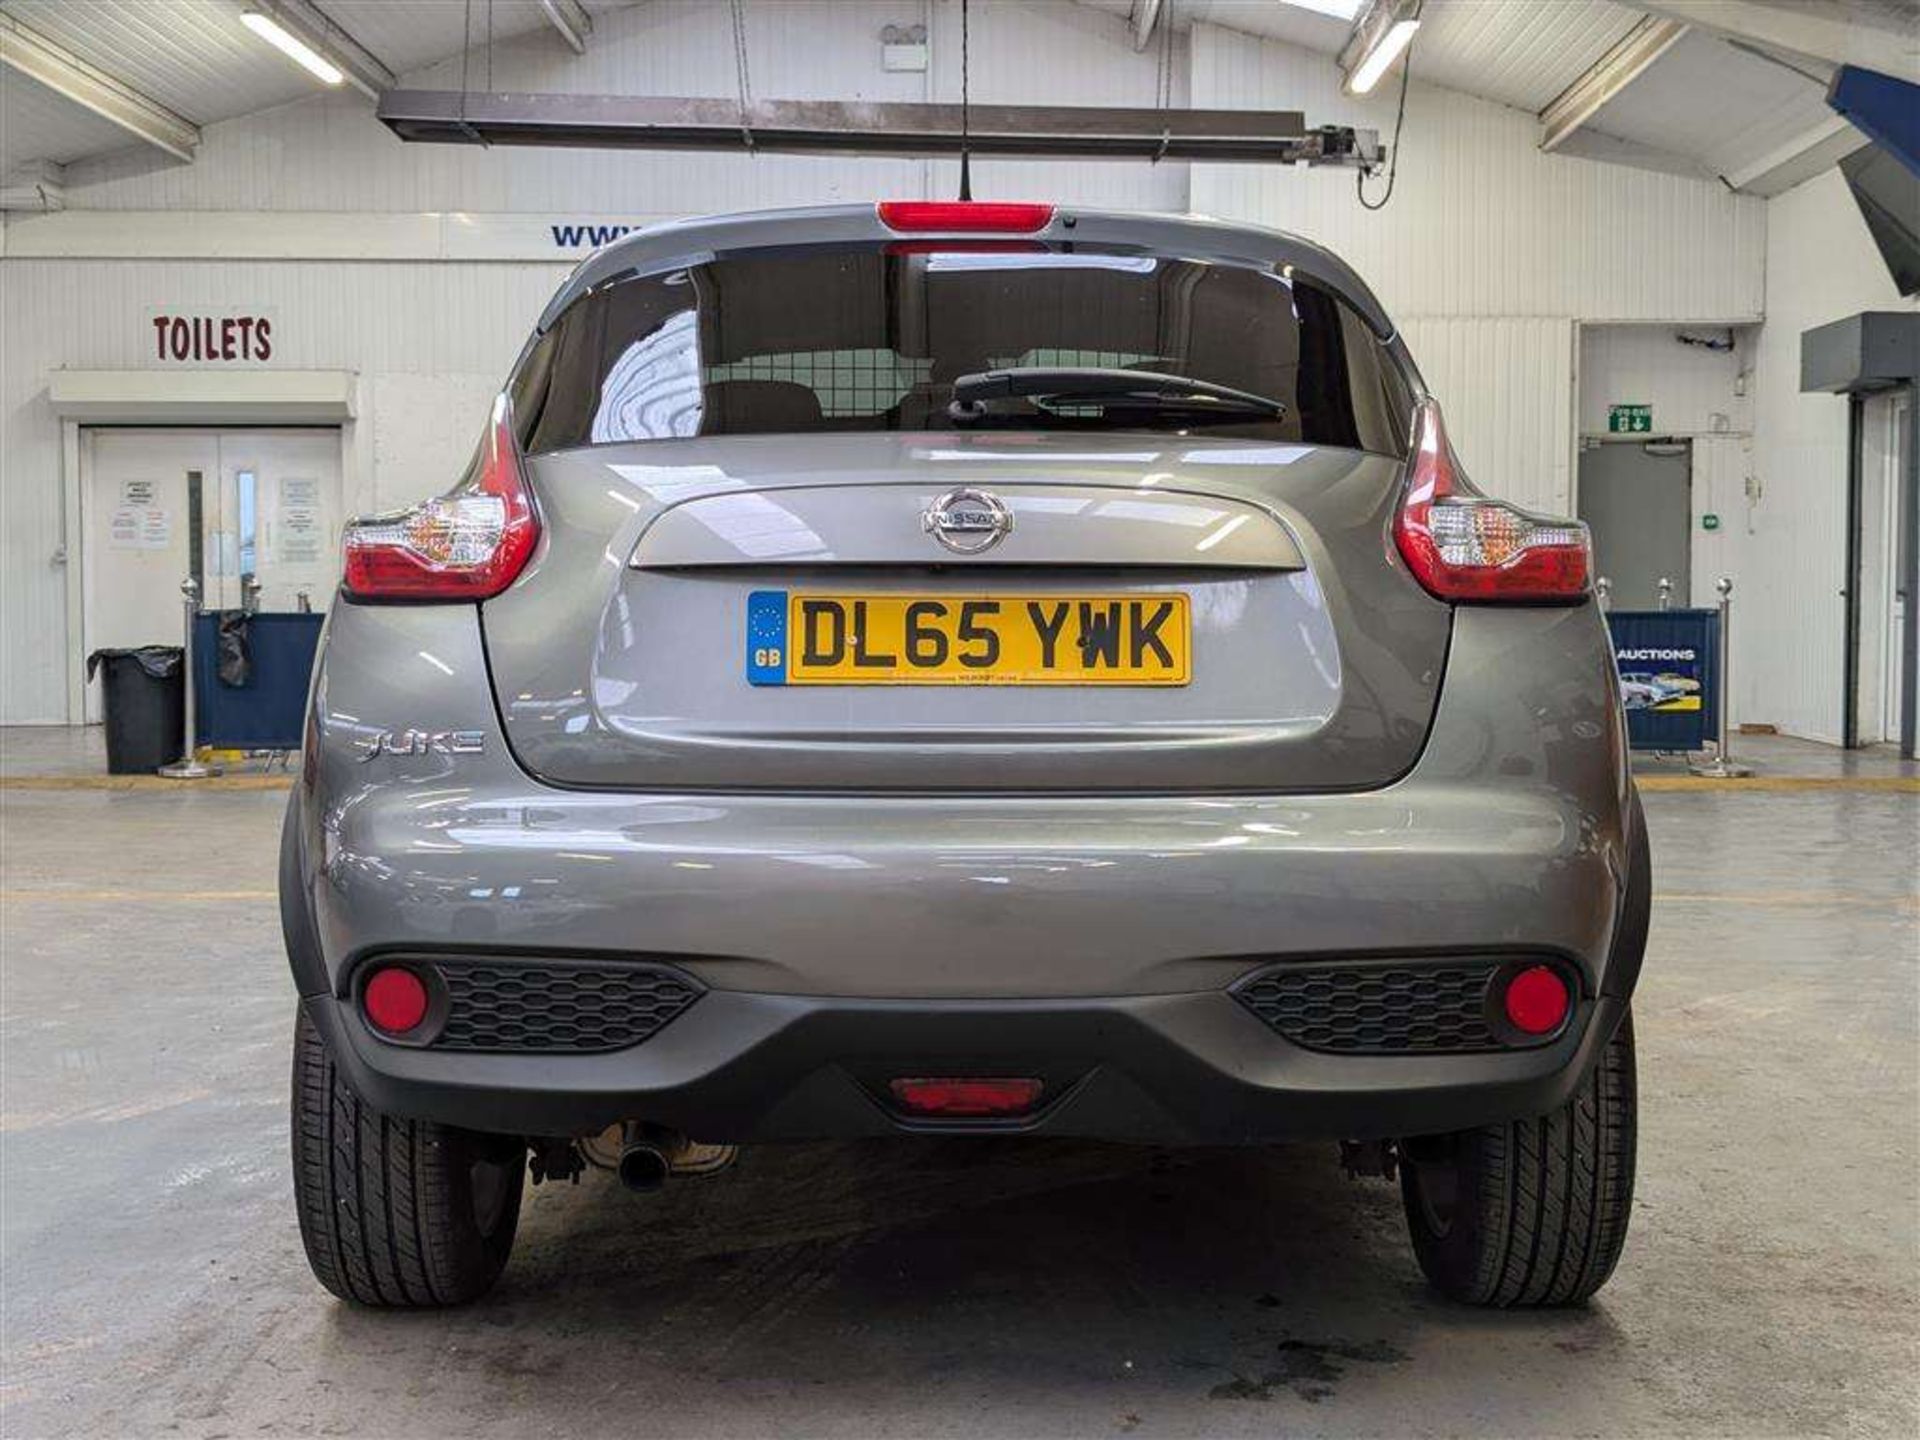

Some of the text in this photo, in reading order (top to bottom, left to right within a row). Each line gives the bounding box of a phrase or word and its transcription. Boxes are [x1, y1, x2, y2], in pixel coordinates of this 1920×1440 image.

[153, 316, 271, 361] TOILETS
[938, 512, 999, 526] NISSAN
[801, 601, 1175, 668] DL65 YWK
[755, 648, 781, 667] GB
[1617, 649, 1696, 660] AUCTIONS
[355, 729, 485, 763] JUKE
